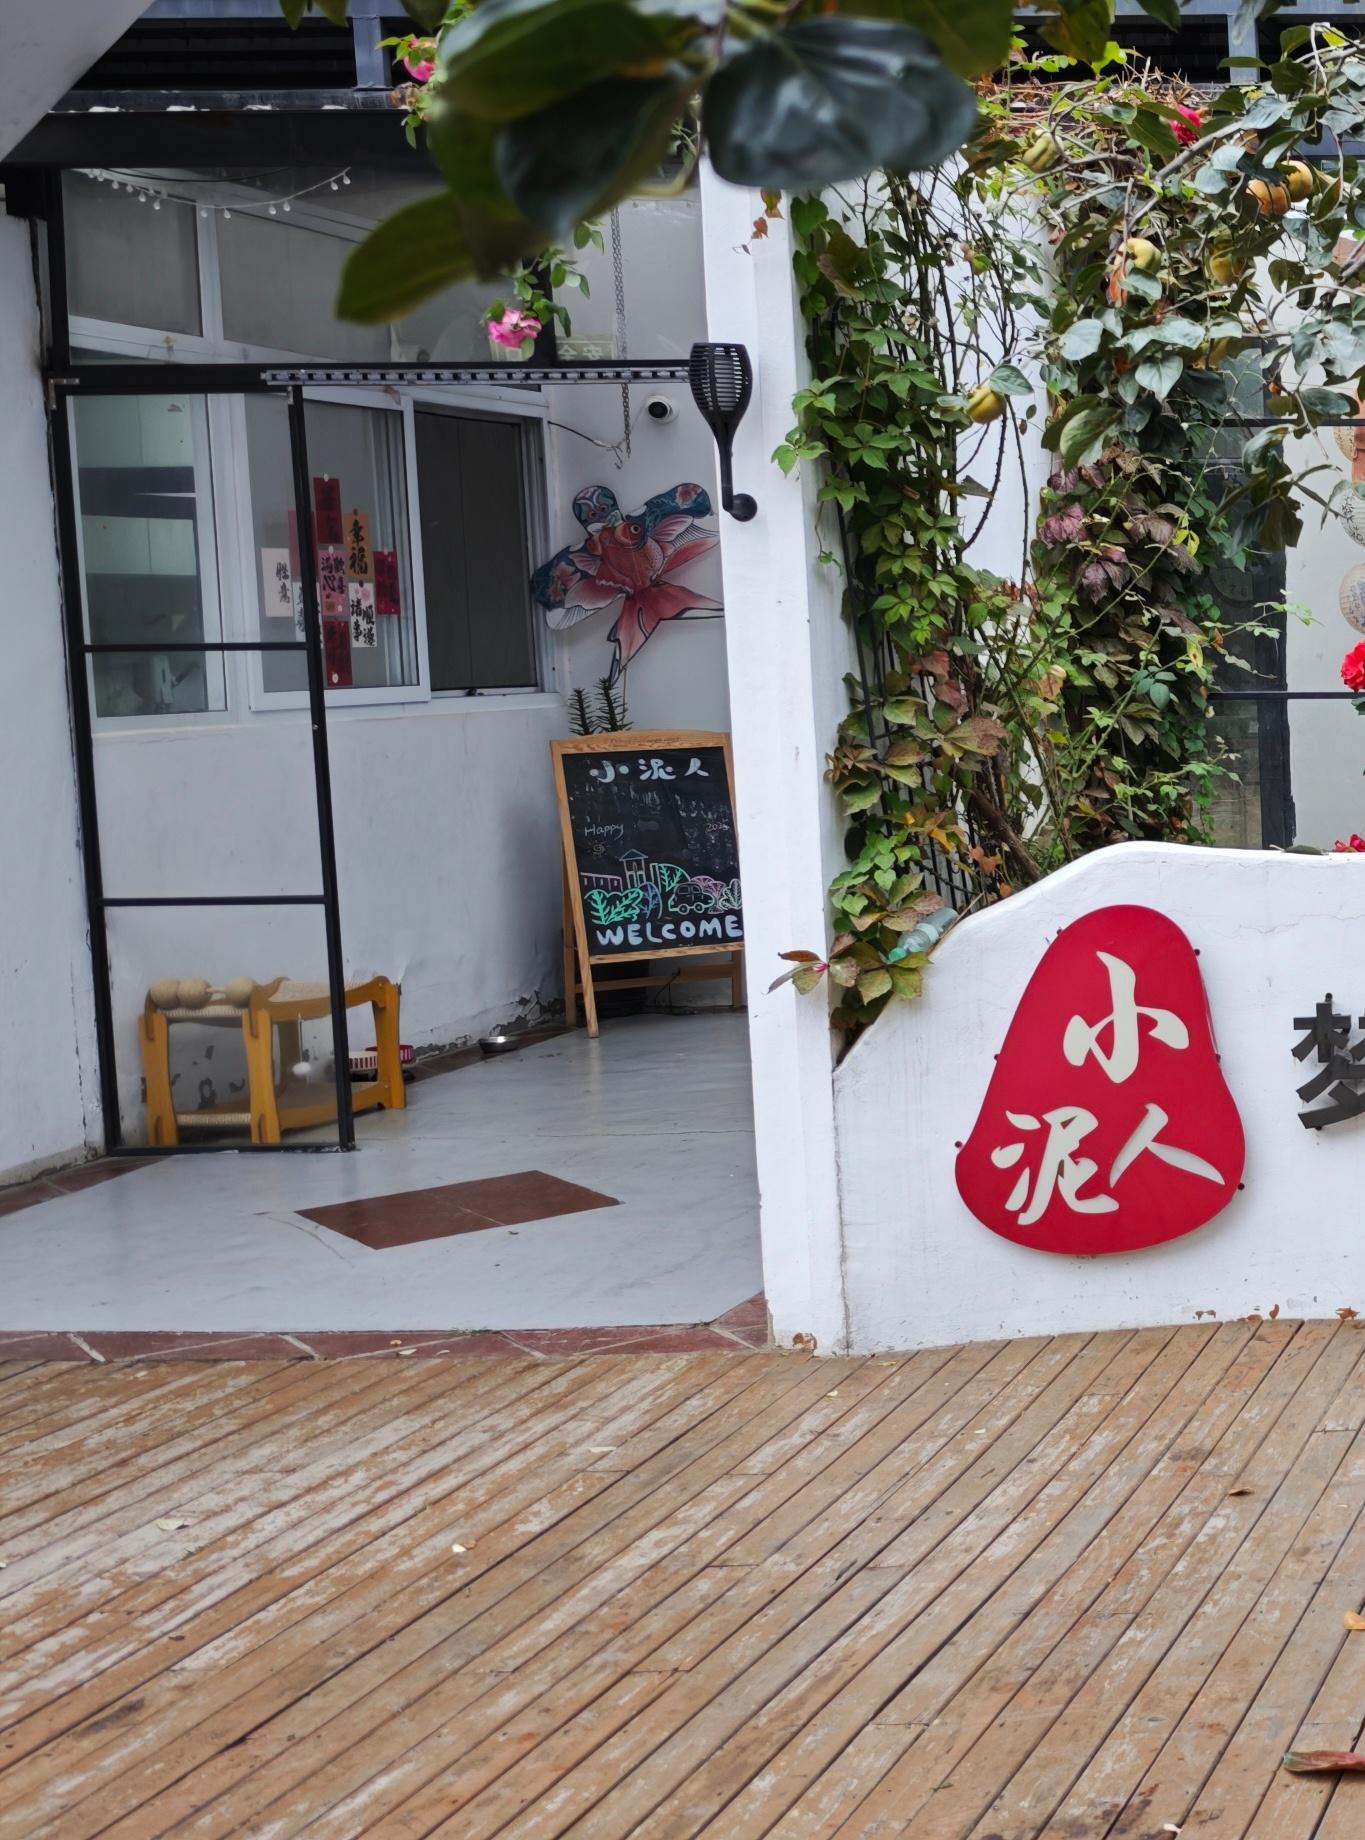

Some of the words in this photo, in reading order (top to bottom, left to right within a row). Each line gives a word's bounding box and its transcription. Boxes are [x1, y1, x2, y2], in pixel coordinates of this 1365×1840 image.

[589, 757, 710, 784] 小泥人
[584, 823, 624, 840] Happy
[596, 914, 744, 946] WELCOME
[1063, 951, 1190, 1084] 小
[991, 1103, 1226, 1226] 泥人
